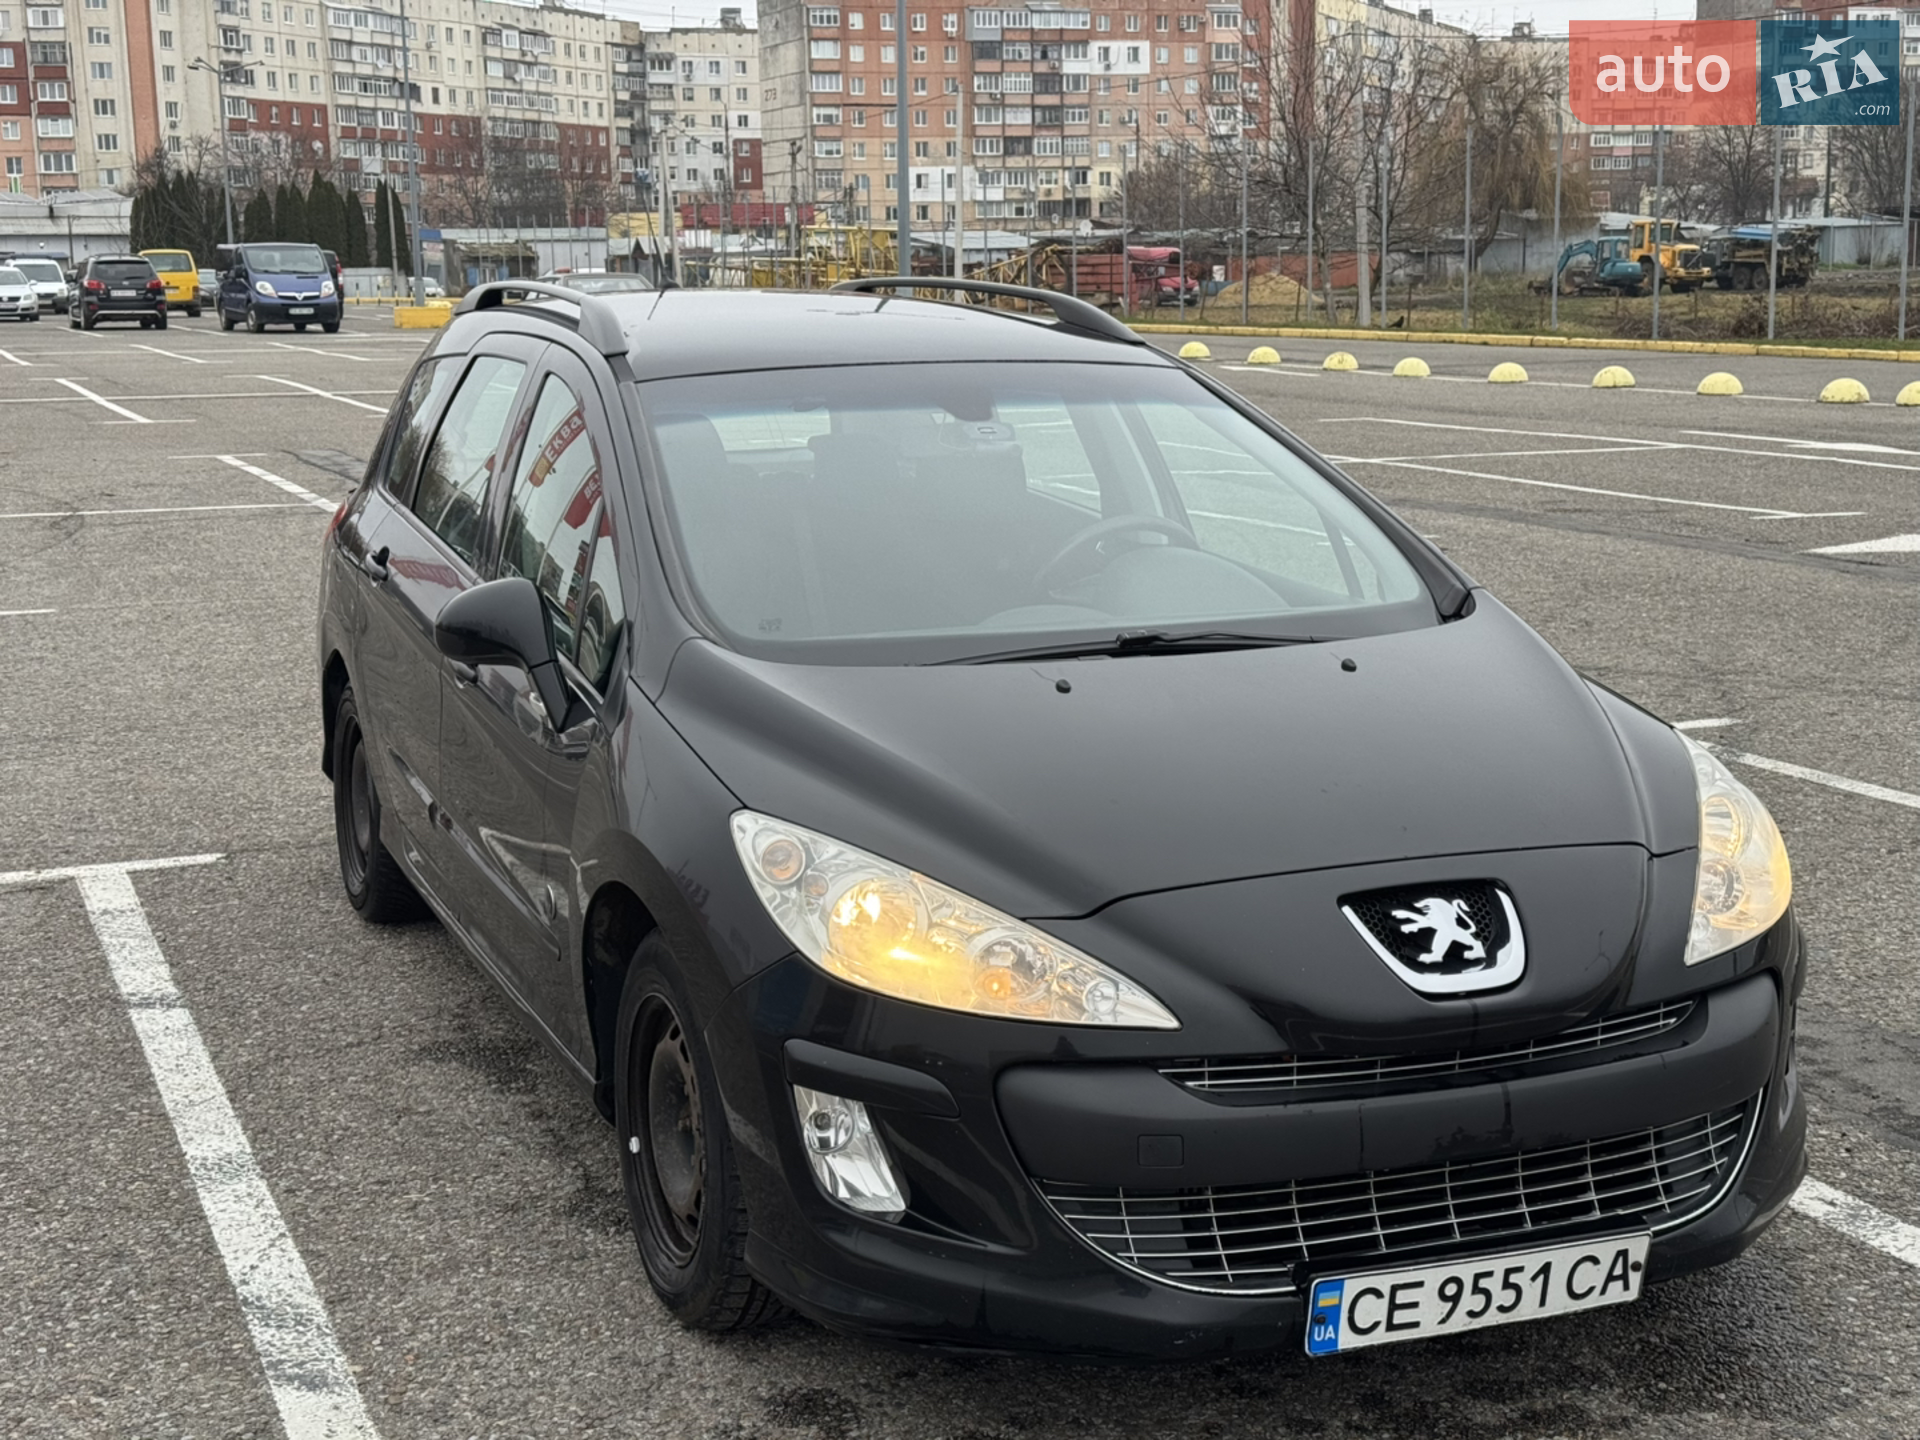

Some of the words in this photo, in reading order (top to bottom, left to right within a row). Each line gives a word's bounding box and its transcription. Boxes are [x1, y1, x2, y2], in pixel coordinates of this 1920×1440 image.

[1347, 1280, 1425, 1336] CE
[1437, 1261, 1552, 1325] 9551
[1566, 1248, 1630, 1301] CA
[1313, 1324, 1336, 1342] UA
